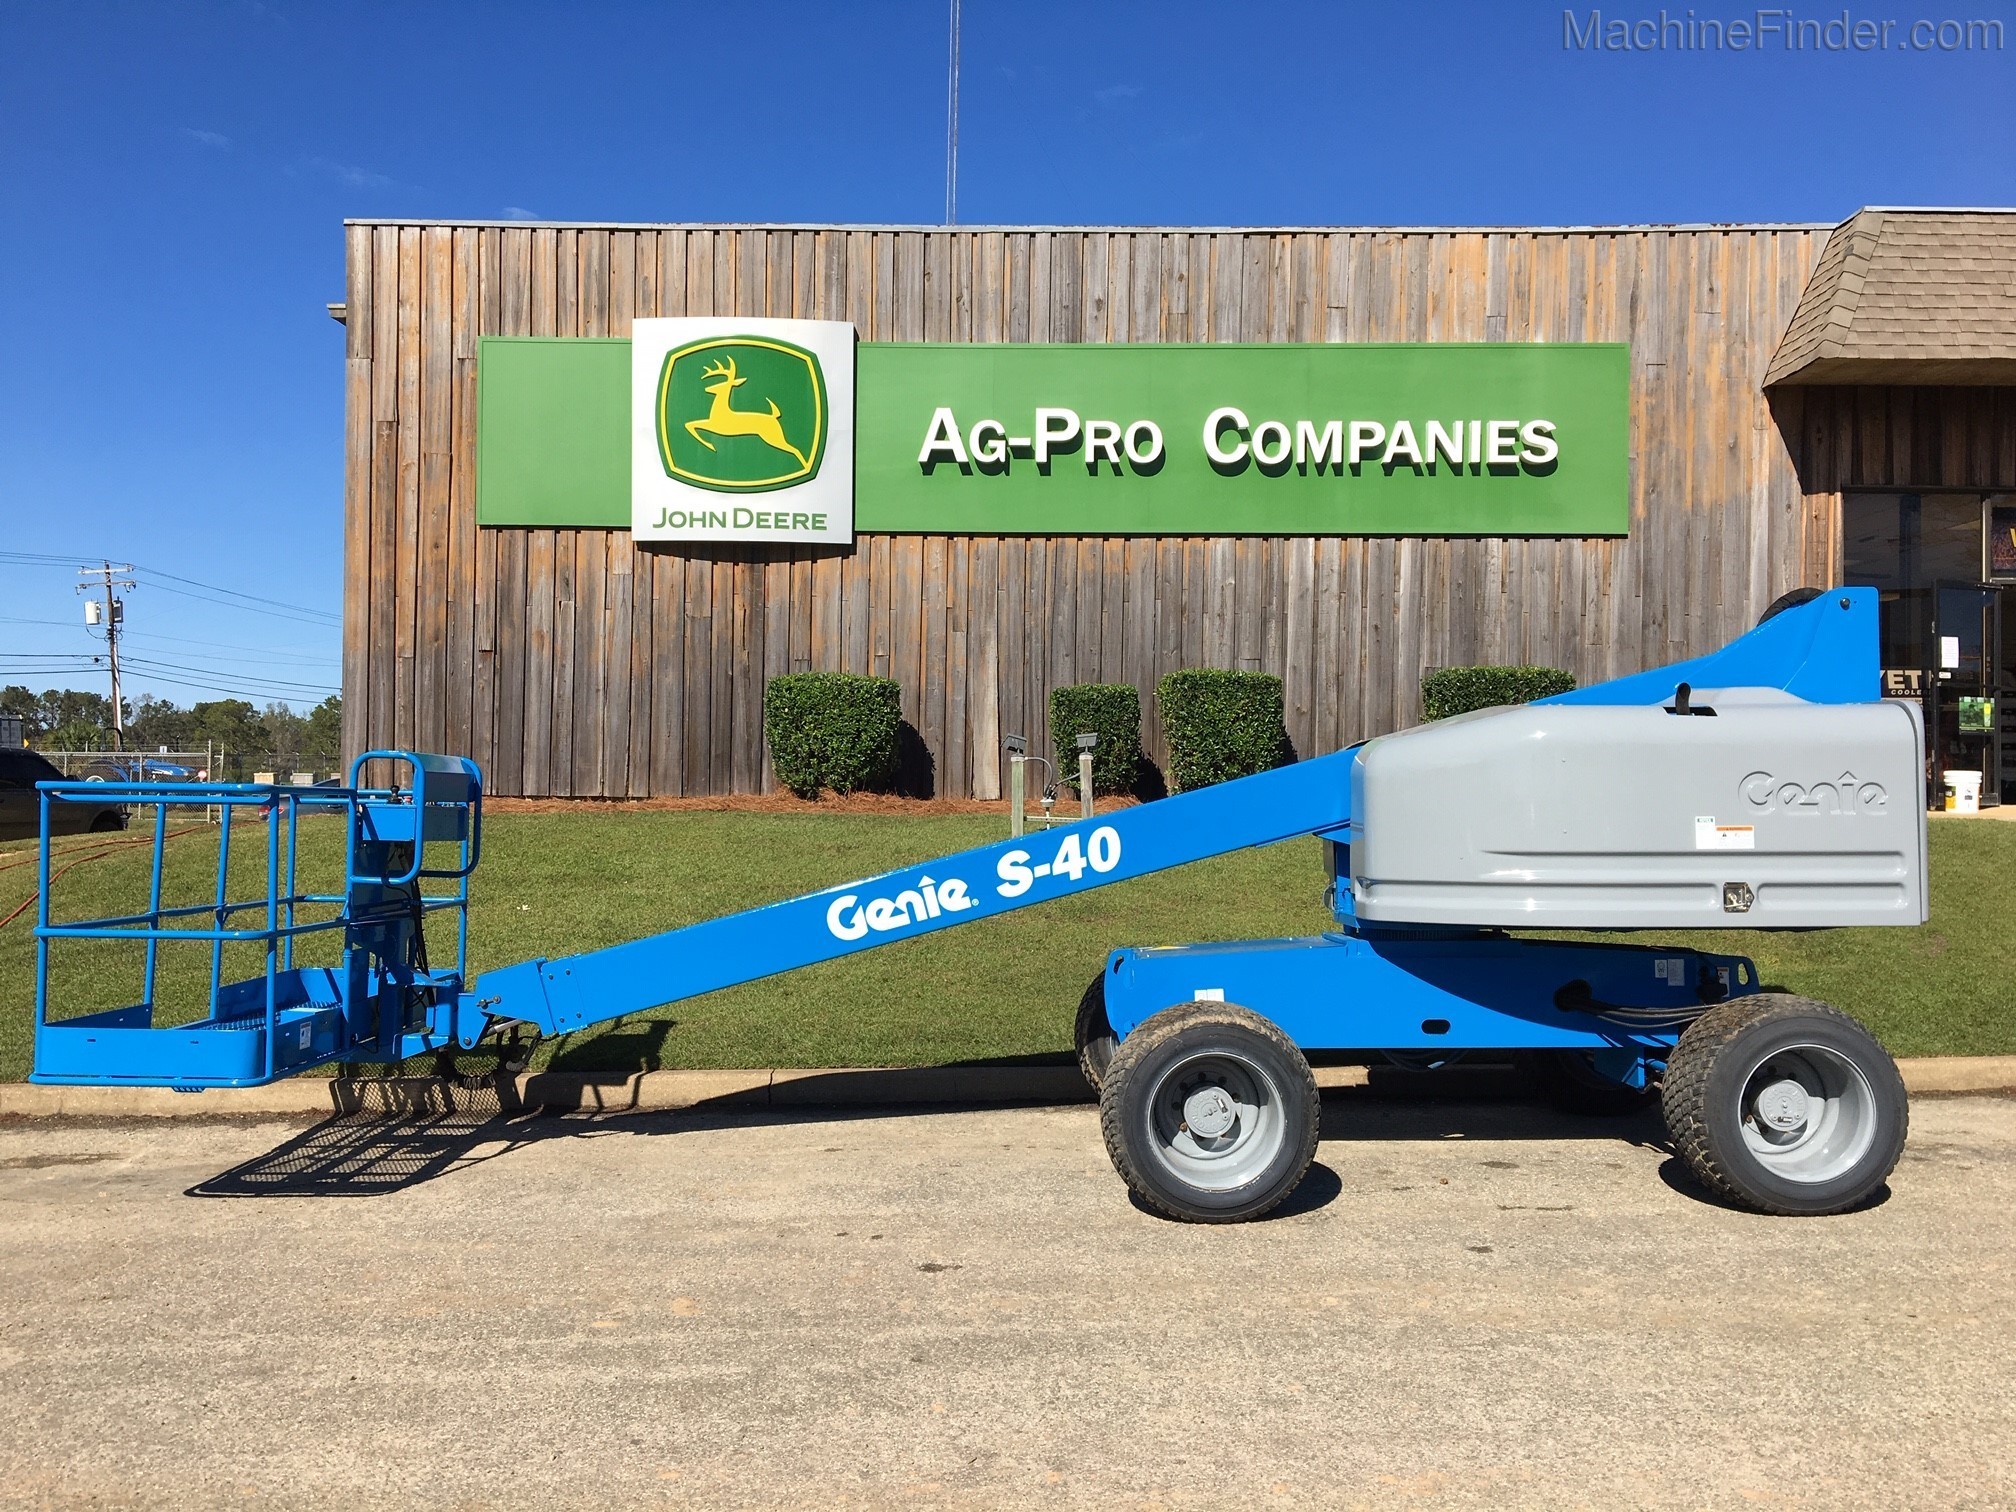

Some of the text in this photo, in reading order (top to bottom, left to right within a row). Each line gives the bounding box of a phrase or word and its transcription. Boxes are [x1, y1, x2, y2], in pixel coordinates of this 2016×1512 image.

[1202, 406, 1559, 465] COMPANIES
[652, 507, 828, 531] JOHN DEERE
[1737, 770, 1889, 817] Genie
[826, 825, 1122, 942] Genie S-40
